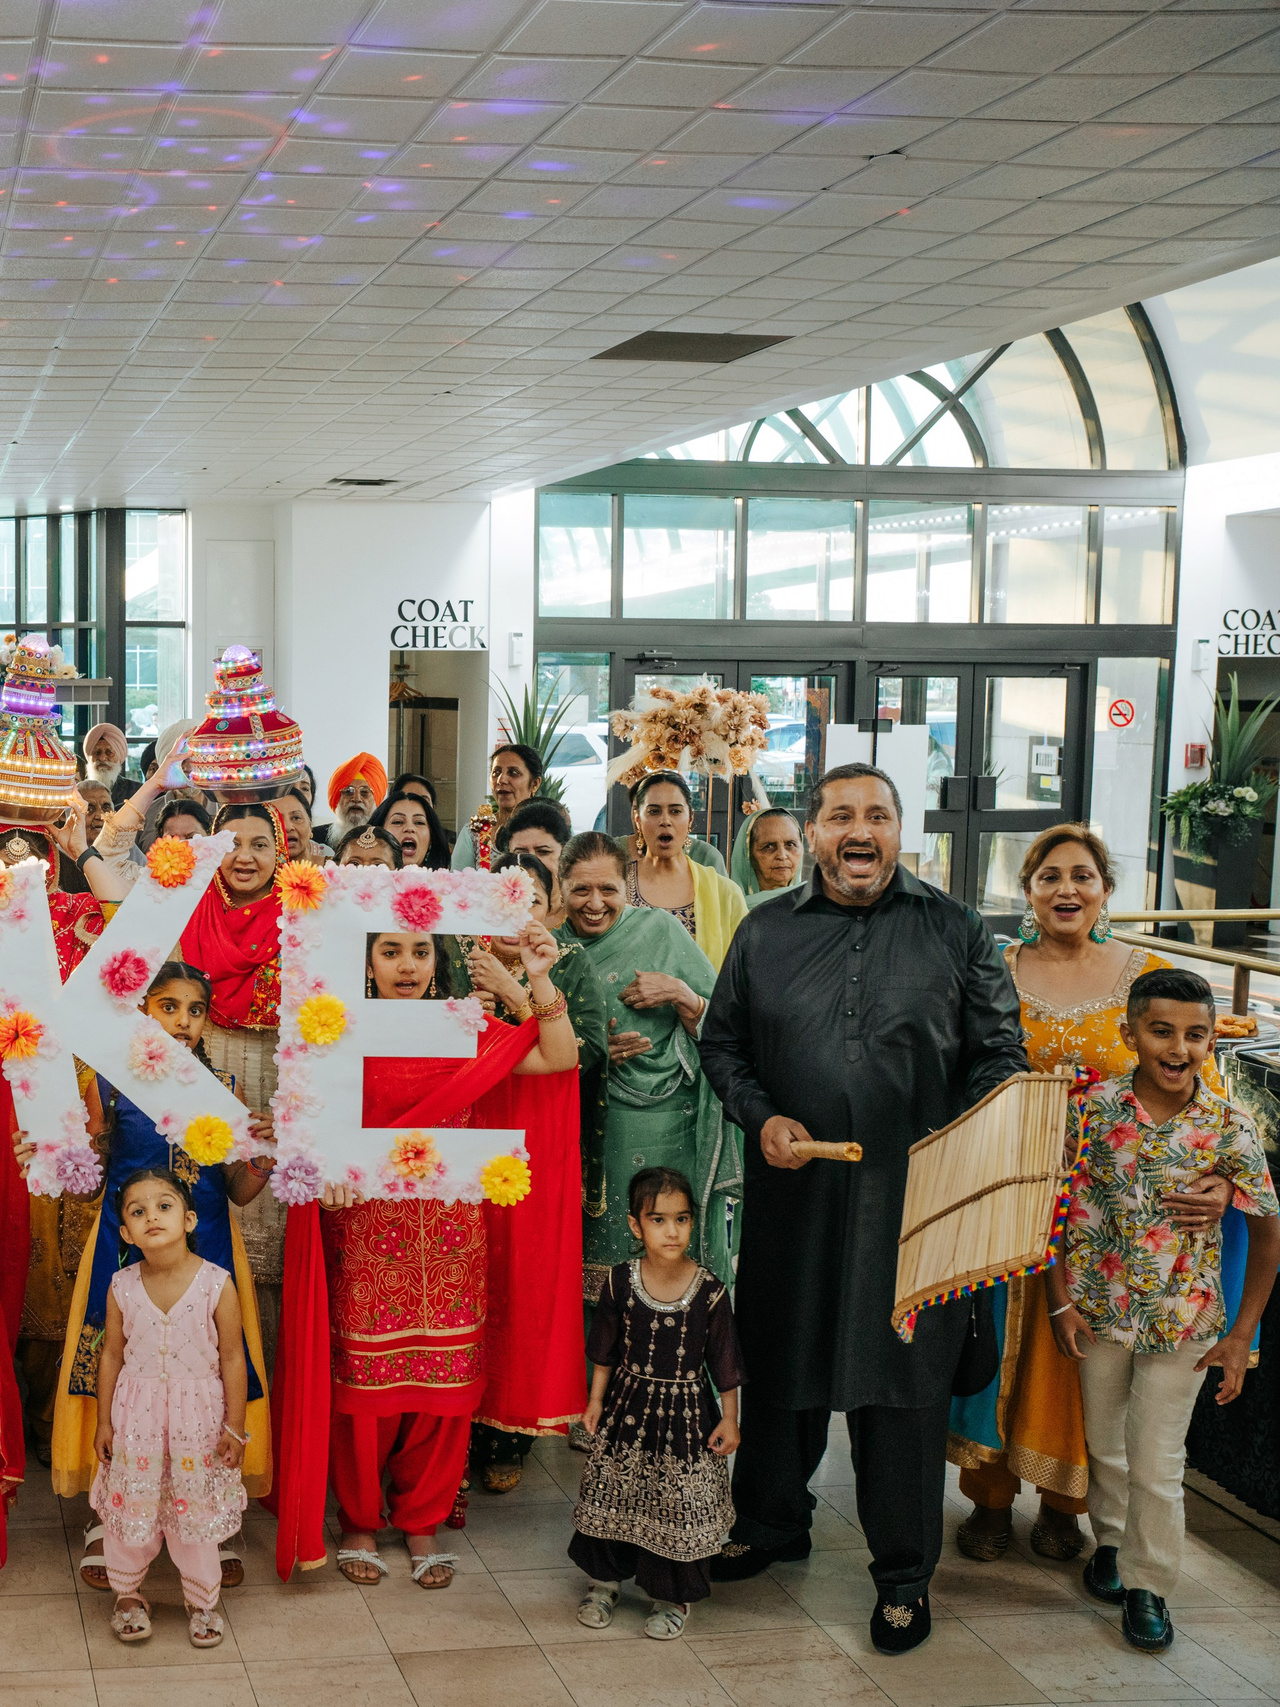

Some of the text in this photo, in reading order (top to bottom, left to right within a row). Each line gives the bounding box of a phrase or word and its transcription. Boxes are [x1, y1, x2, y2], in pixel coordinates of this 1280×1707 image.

[397, 598, 474, 622] COAT
[1222, 608, 1280, 631] COA
[390, 625, 487, 648] CHECK
